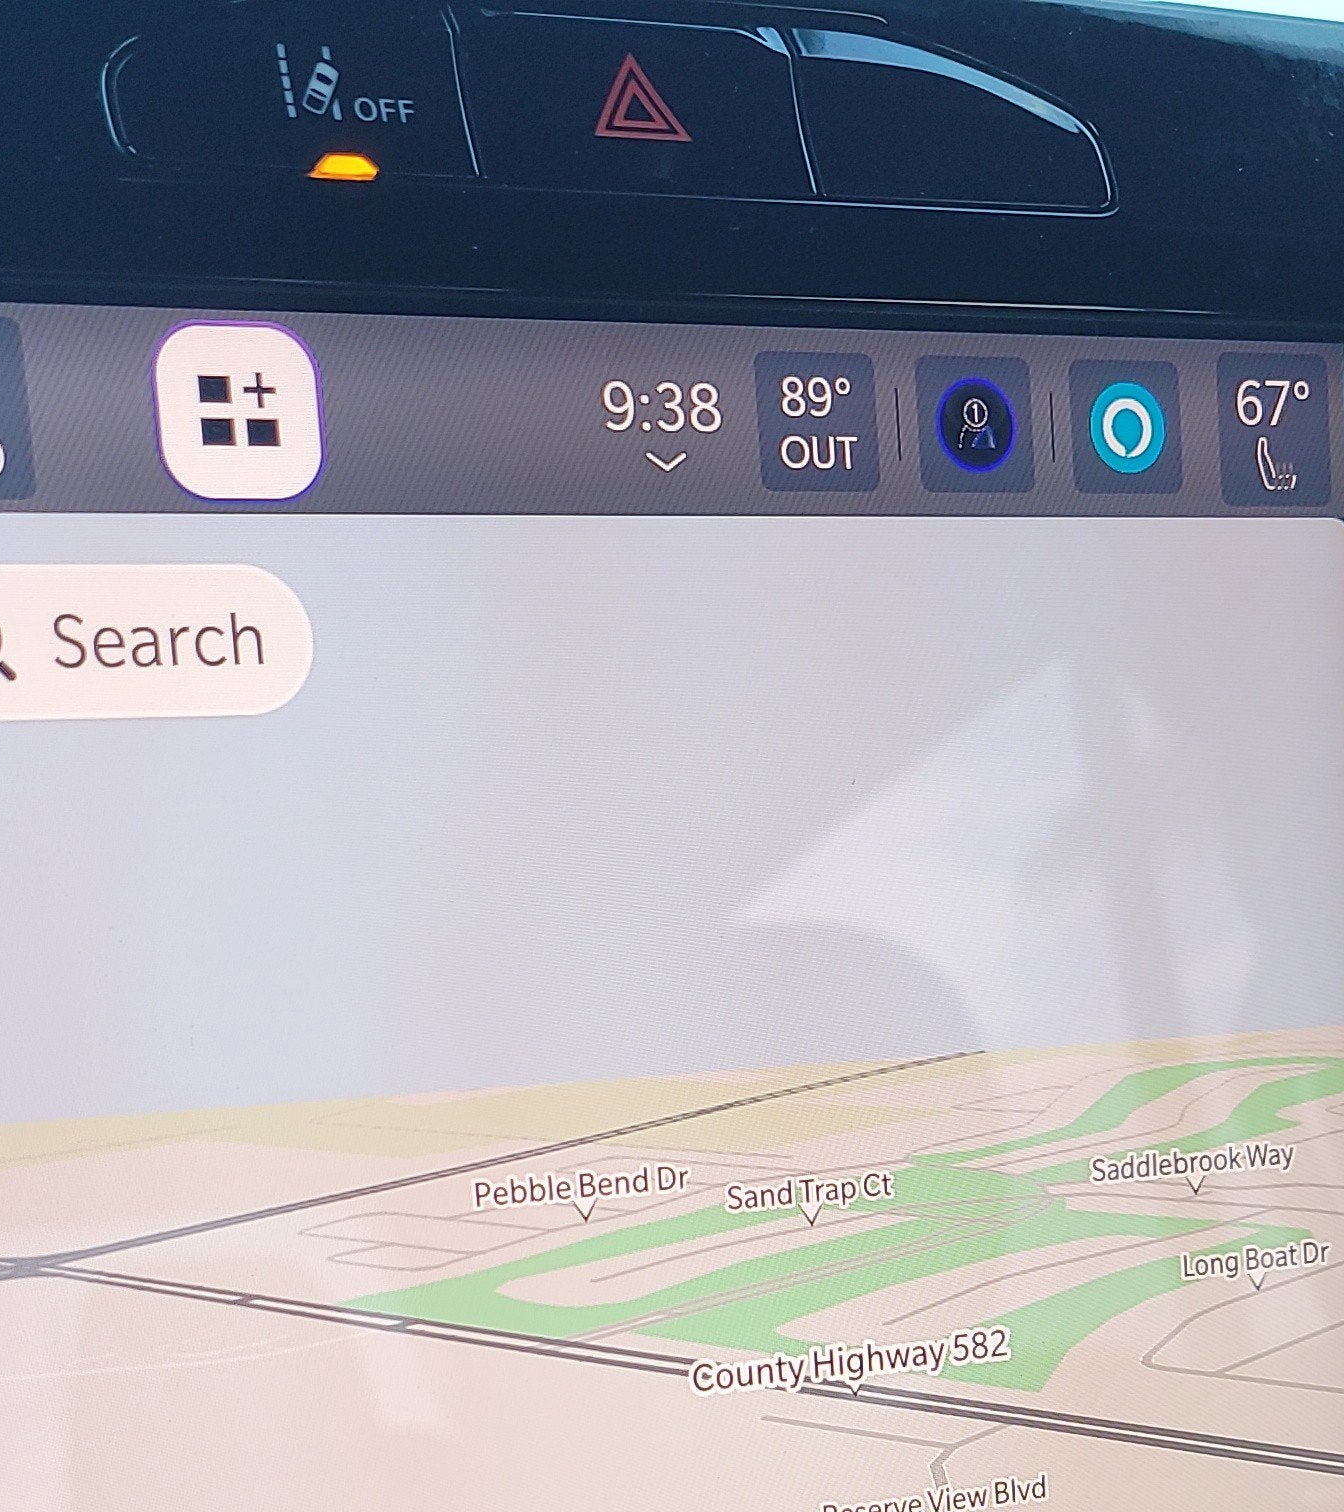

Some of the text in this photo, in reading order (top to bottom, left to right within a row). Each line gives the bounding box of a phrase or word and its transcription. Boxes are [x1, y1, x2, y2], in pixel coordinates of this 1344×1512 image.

[354, 98, 415, 124] OFF
[601, 378, 723, 435] 9:38
[779, 435, 858, 472] OUT
[52, 612, 265, 670] Search
[1090, 1143, 1295, 1183] Saddlebrook Way
[474, 1165, 690, 1209] Pebble Bend Dr
[726, 1173, 893, 1212] Sand Trap Ct
[1182, 1242, 1331, 1279] Long Boat Dr
[692, 1328, 1009, 1393] County Highway 582
[994, 1474, 1048, 1505] Blvd
